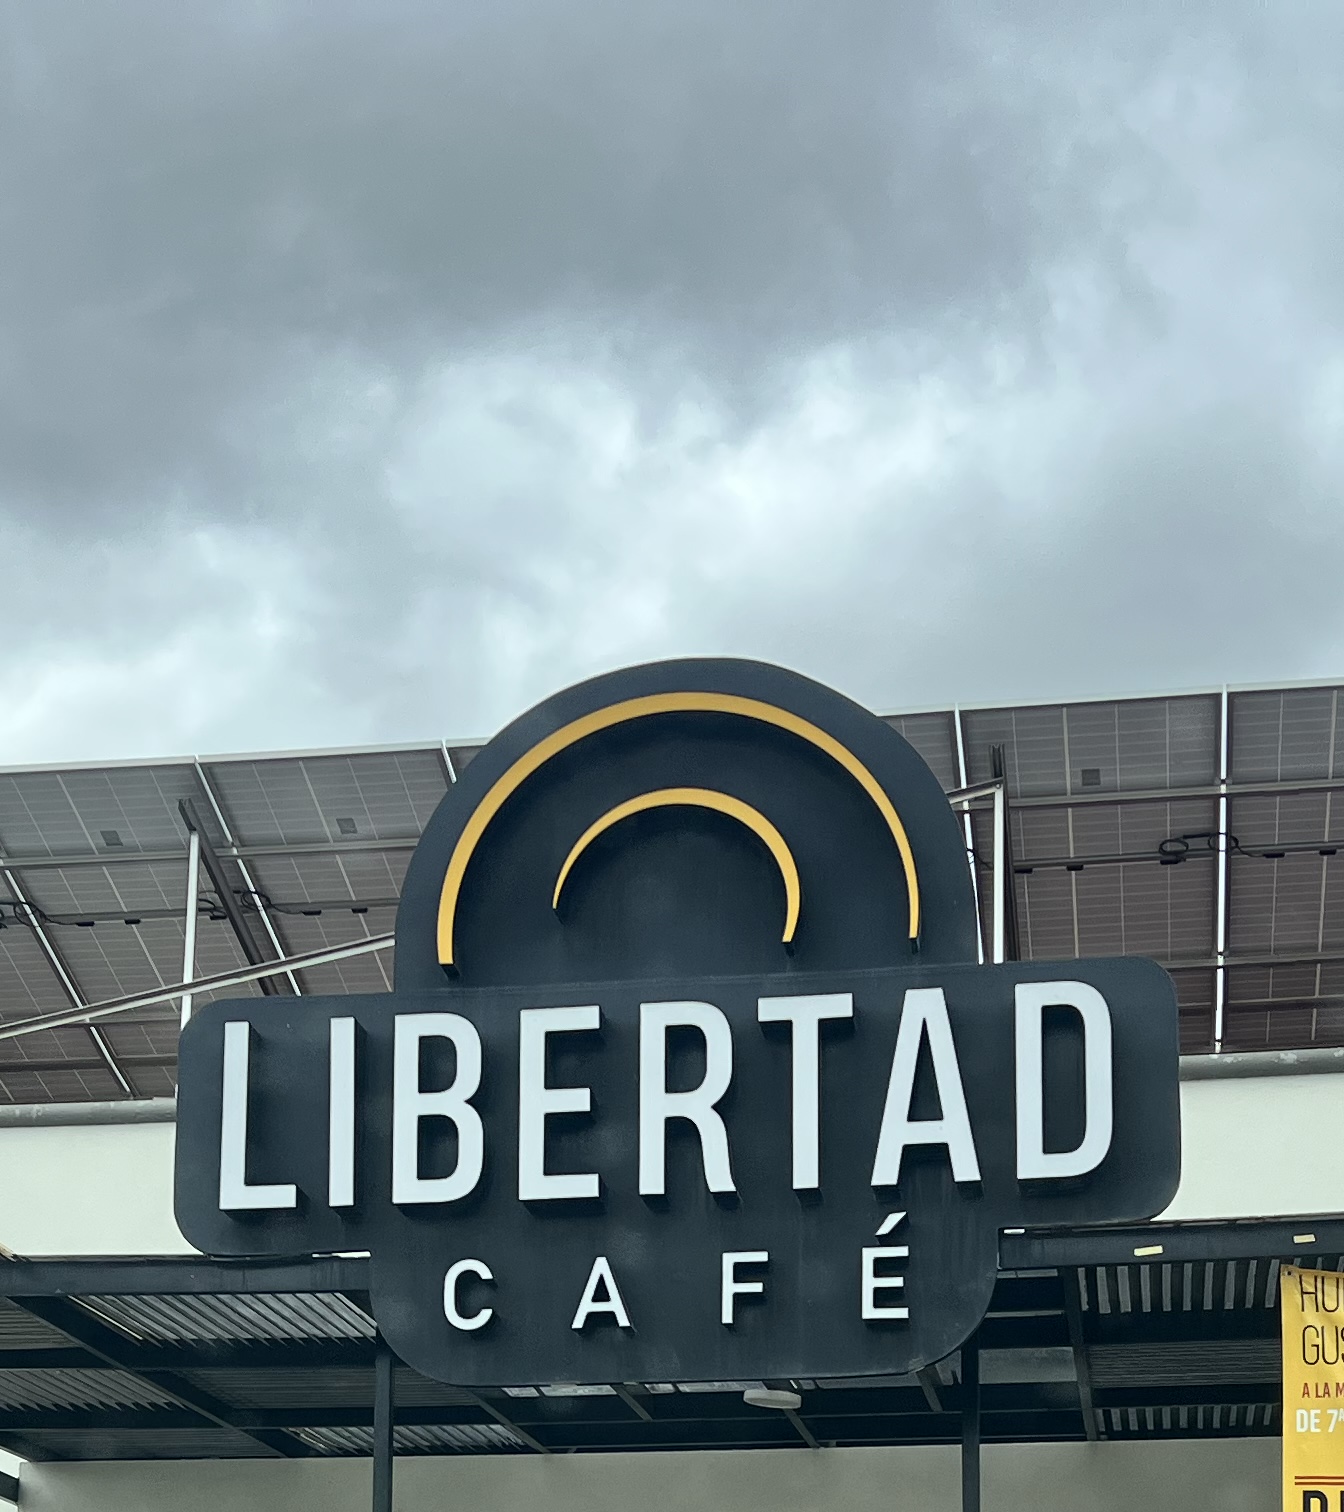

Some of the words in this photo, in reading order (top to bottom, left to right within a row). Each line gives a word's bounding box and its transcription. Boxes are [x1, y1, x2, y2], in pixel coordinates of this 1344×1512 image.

[218, 980, 1114, 1210] LIBERTAD
[443, 1211, 910, 1331] CAFÉ
[1295, 1409, 1321, 1433] DE
[1301, 1382, 1310, 1398] A
[1315, 1382, 1330, 1398] LA
